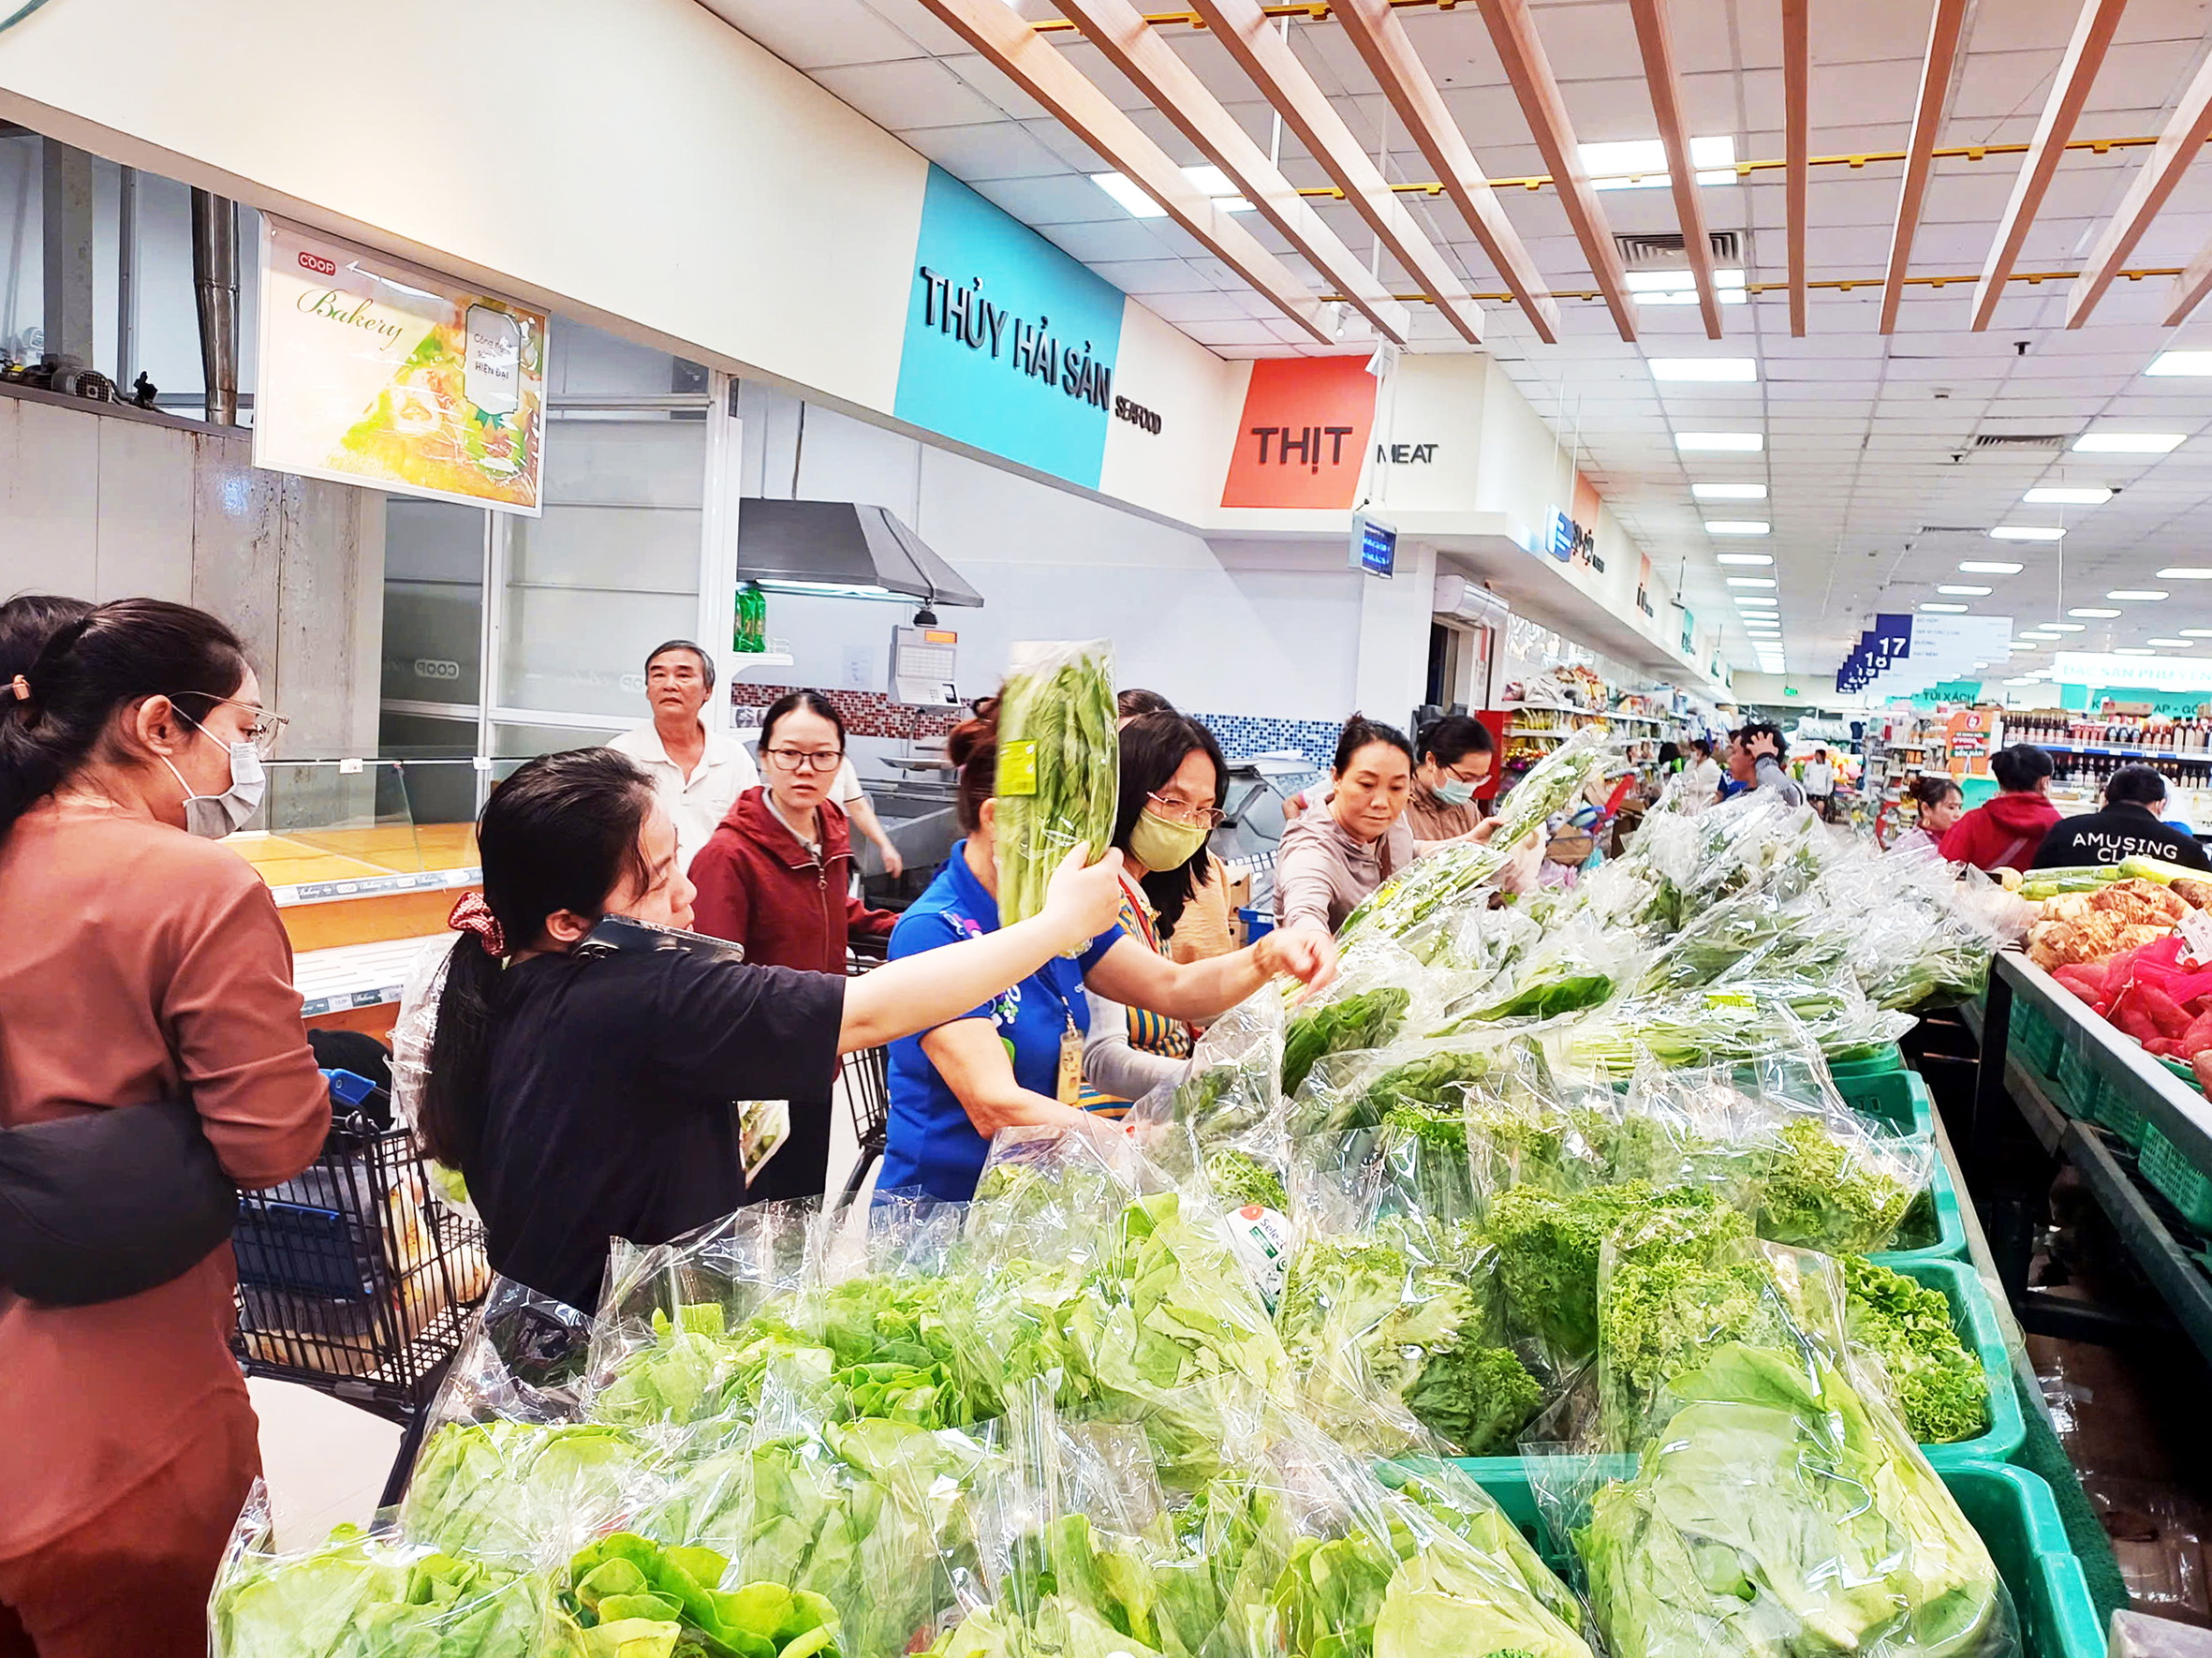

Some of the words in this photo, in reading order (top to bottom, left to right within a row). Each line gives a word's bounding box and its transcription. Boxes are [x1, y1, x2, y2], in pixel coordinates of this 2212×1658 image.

[299, 253, 335, 274] COOP
[296, 289, 405, 351] Bakery
[920, 266, 1010, 358] THỦY
[1012, 315, 1060, 387] HẢI
[1061, 339, 1112, 411] SẢN
[1114, 394, 1162, 435] SEAFOOD
[1251, 426, 1353, 475] THỊT
[1377, 443, 1439, 465] MEAT
[1879, 637, 1907, 657] 17
[1943, 691, 1976, 703] XÁCH
[2072, 832, 2178, 860] AMUSING
